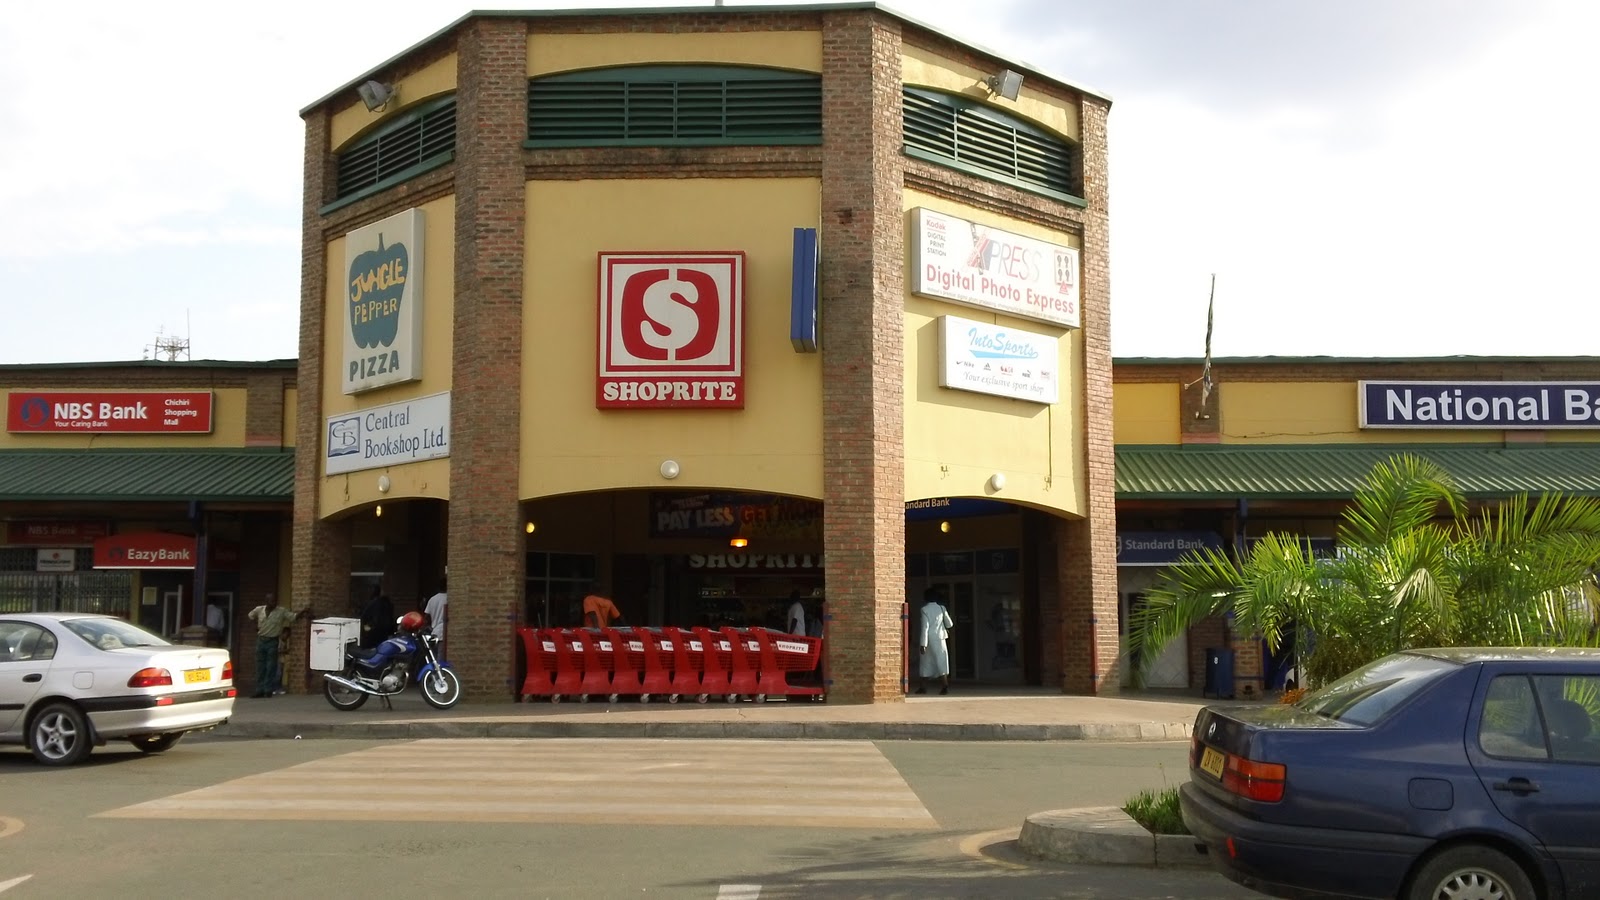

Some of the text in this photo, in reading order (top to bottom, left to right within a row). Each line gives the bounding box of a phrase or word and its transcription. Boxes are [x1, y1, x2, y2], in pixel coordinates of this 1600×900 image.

[926, 218, 946, 230] Kodak
[927, 232, 947, 242] DIGITAL
[929, 240, 945, 249] PRINT
[927, 247, 947, 257] STATION
[351, 258, 406, 302] JUNGLE
[926, 264, 975, 291] Digital
[981, 277, 1020, 302] Photo
[1026, 289, 1074, 314] Express
[354, 297, 397, 325] PEPPER
[349, 350, 400, 382] PIZZA
[963, 372, 980, 382] Your
[980, 375, 1011, 388] exclusive
[1012, 380, 1028, 392] sport
[603, 381, 737, 402] SHOPRITE
[164, 398, 190, 406] Chichiri
[1386, 389, 1600, 421] National B
[54, 402, 148, 419] NBS Bank
[164, 408, 197, 417] Shopping
[54, 420, 108, 428] Your Caring Bank
[164, 418, 179, 426] Mall
[365, 406, 410, 432] Central
[364, 428, 447, 460] Bookshop Ltd.
[906, 498, 950, 510] andard Bank
[657, 510, 692, 531] PAY
[696, 506, 735, 528] LESS
[1126, 538, 1205, 551] Standard Bank
[127, 548, 190, 562] EazyBank
